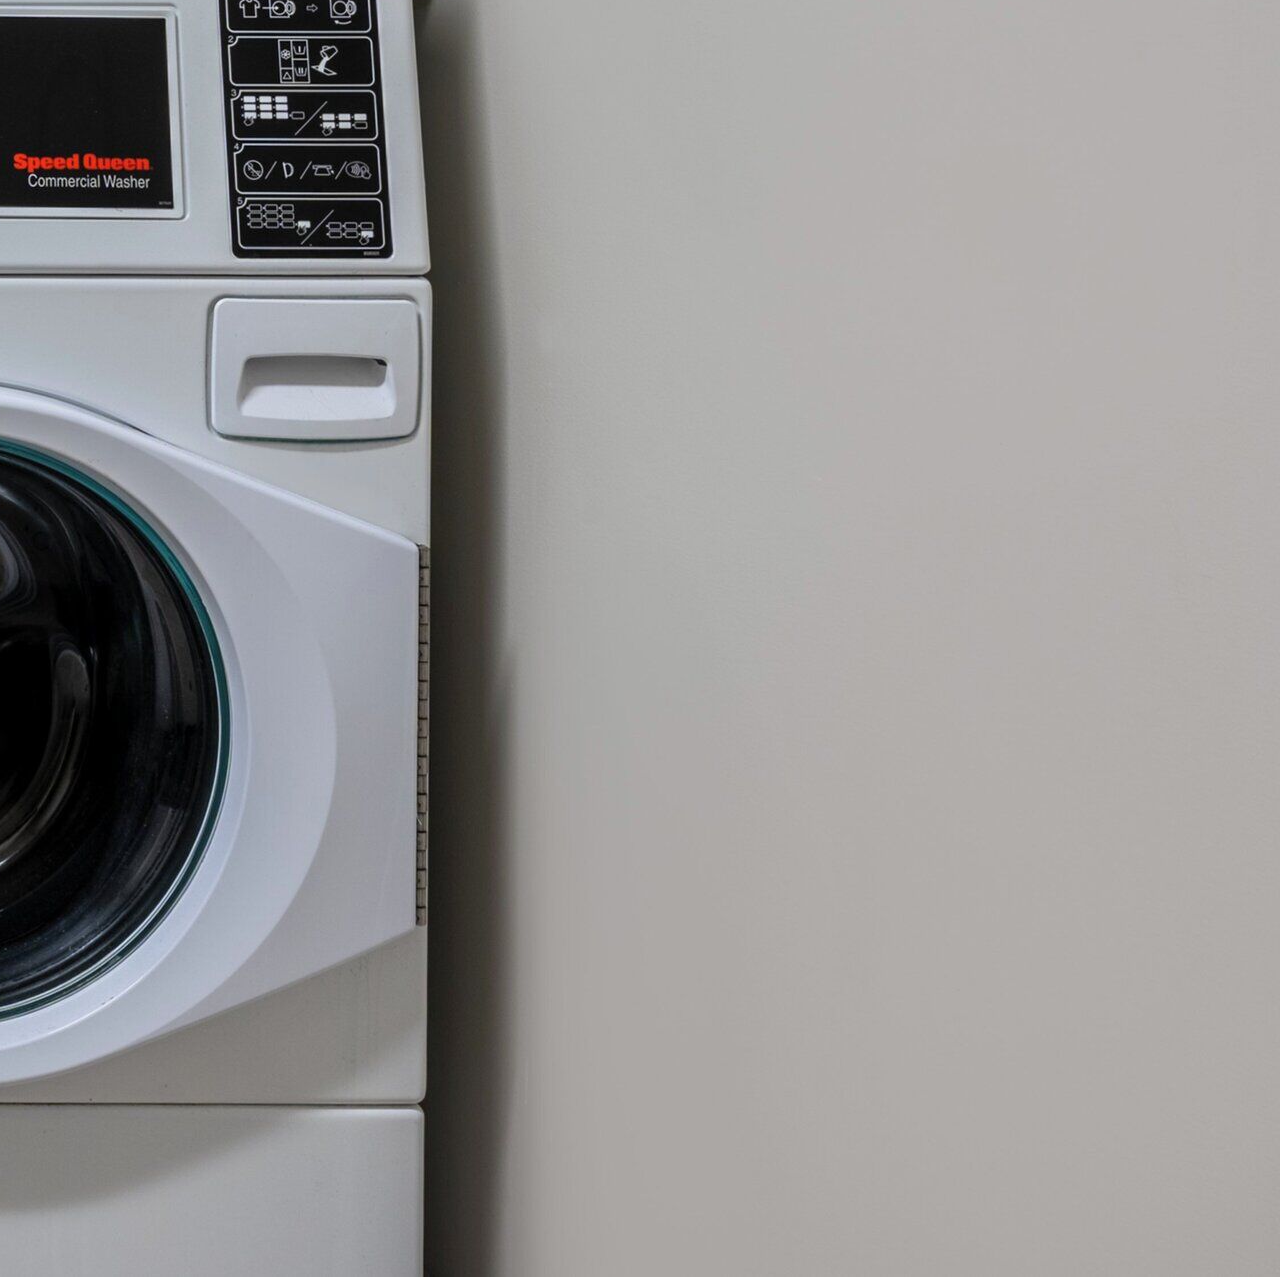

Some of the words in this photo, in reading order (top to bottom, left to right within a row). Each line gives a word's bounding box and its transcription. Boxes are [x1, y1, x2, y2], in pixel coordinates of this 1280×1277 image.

[228, 35, 234, 43] 2
[13, 153, 79, 172] Speed
[83, 154, 150, 171] Queen
[27, 173, 100, 188] Commercial
[103, 175, 150, 189] Washer
